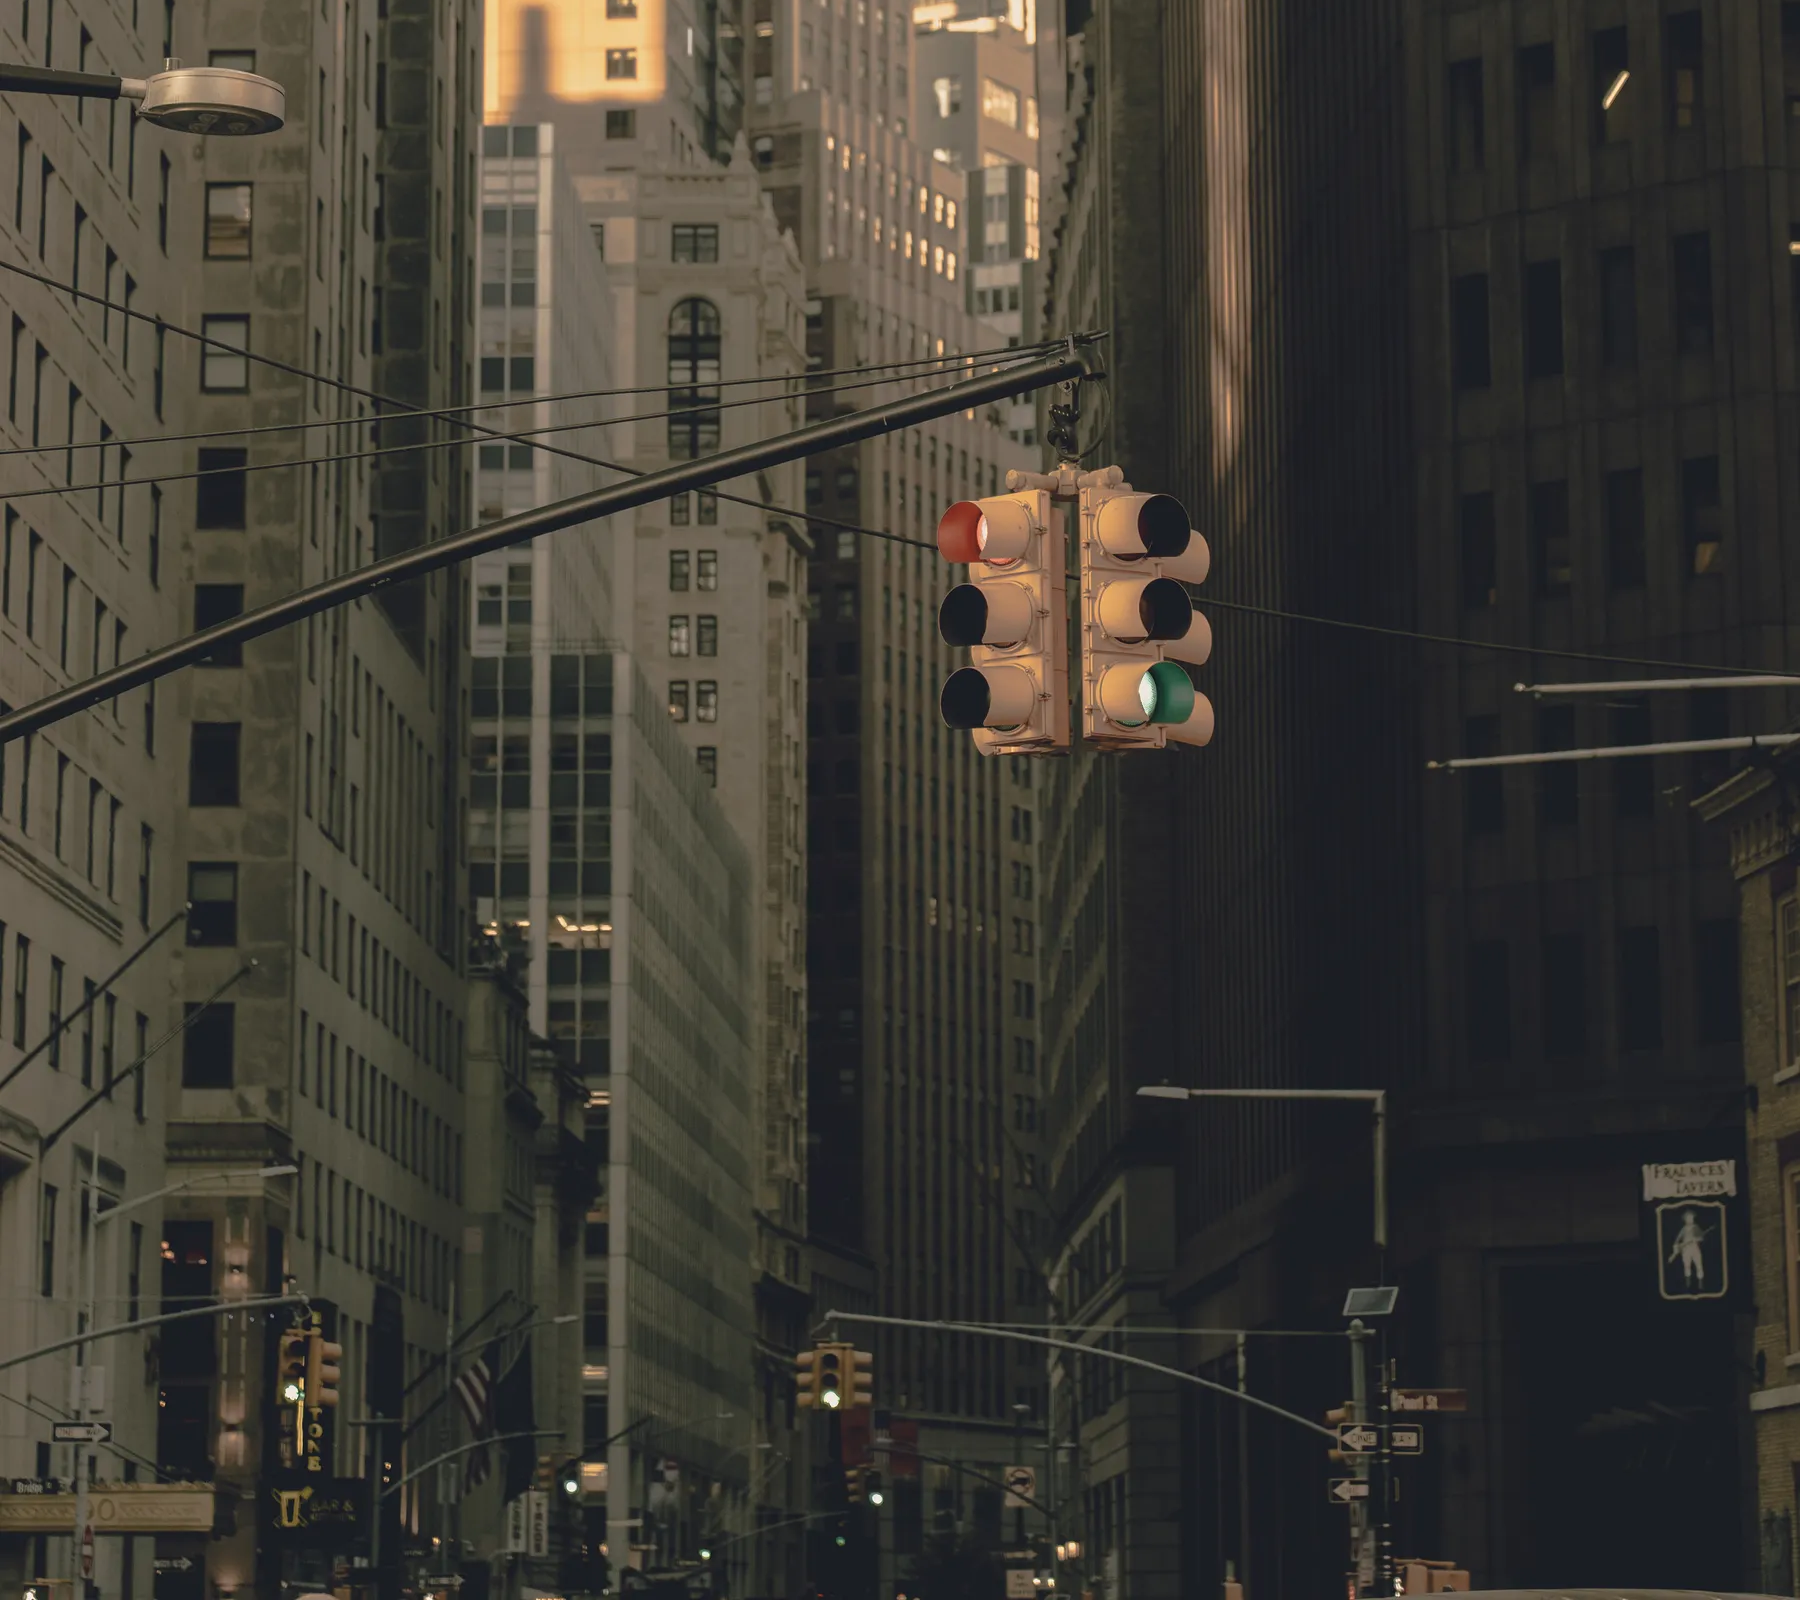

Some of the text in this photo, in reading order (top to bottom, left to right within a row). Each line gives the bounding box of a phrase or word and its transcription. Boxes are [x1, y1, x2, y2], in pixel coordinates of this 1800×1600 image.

[1654, 1165, 1725, 1179] FRAUNCES
[1674, 1179, 1724, 1194] TAVERN
[1352, 1433, 1376, 1444] ONE
